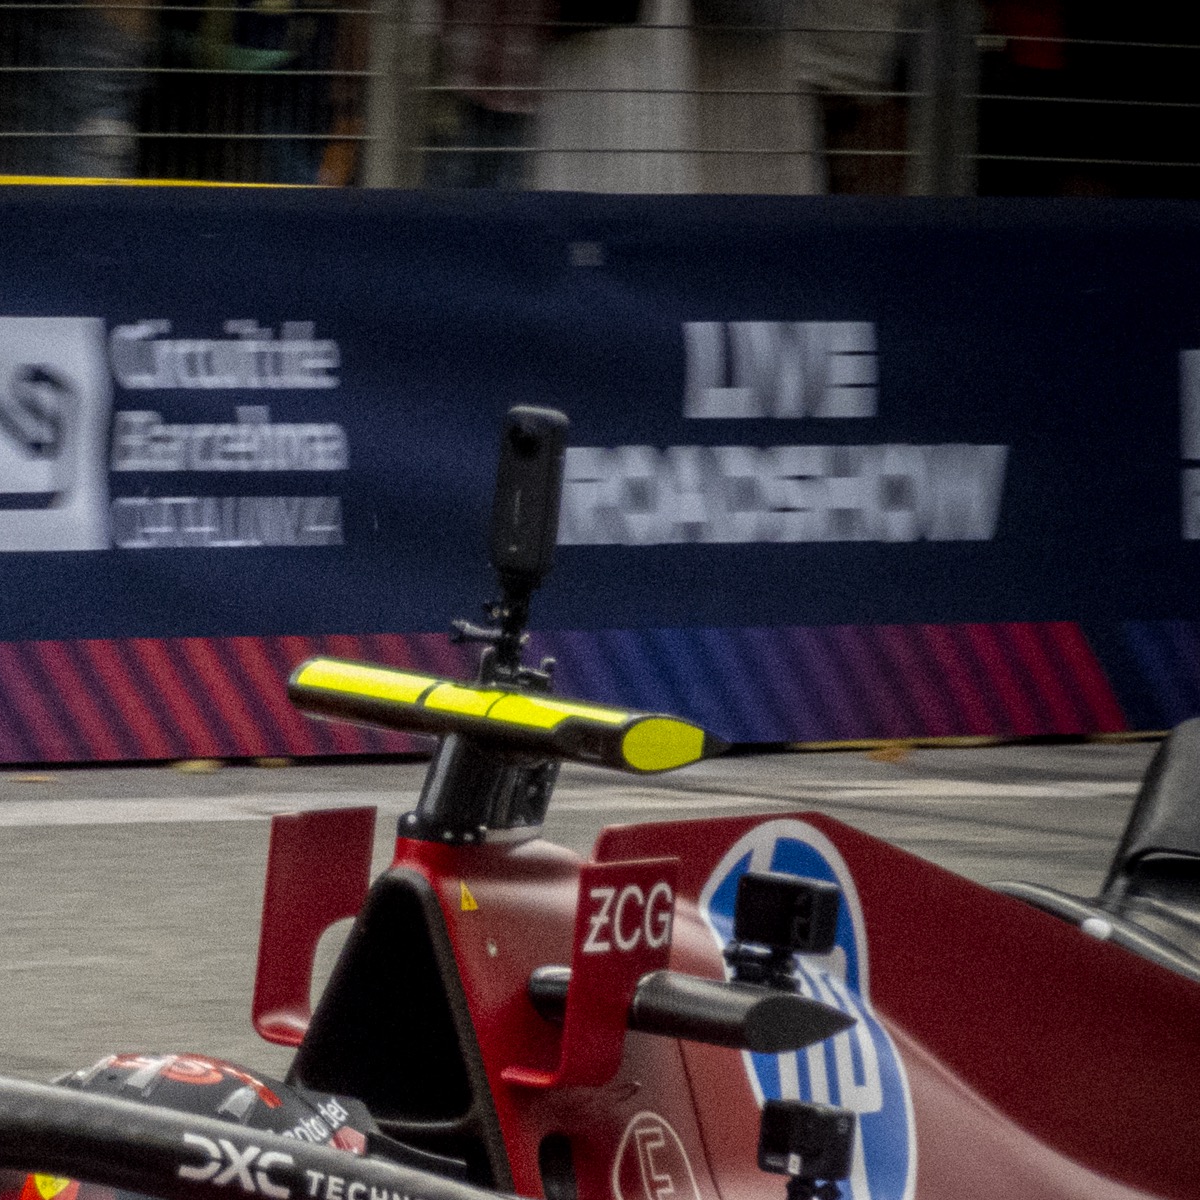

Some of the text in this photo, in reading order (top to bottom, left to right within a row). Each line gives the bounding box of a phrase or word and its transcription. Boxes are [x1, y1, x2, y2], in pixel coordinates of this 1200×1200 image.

[685, 321, 878, 418] LIVE
[557, 444, 1009, 545] ROADSHOW
[583, 882, 675, 954] ZCG
[178, 1132, 295, 1200] DXC
